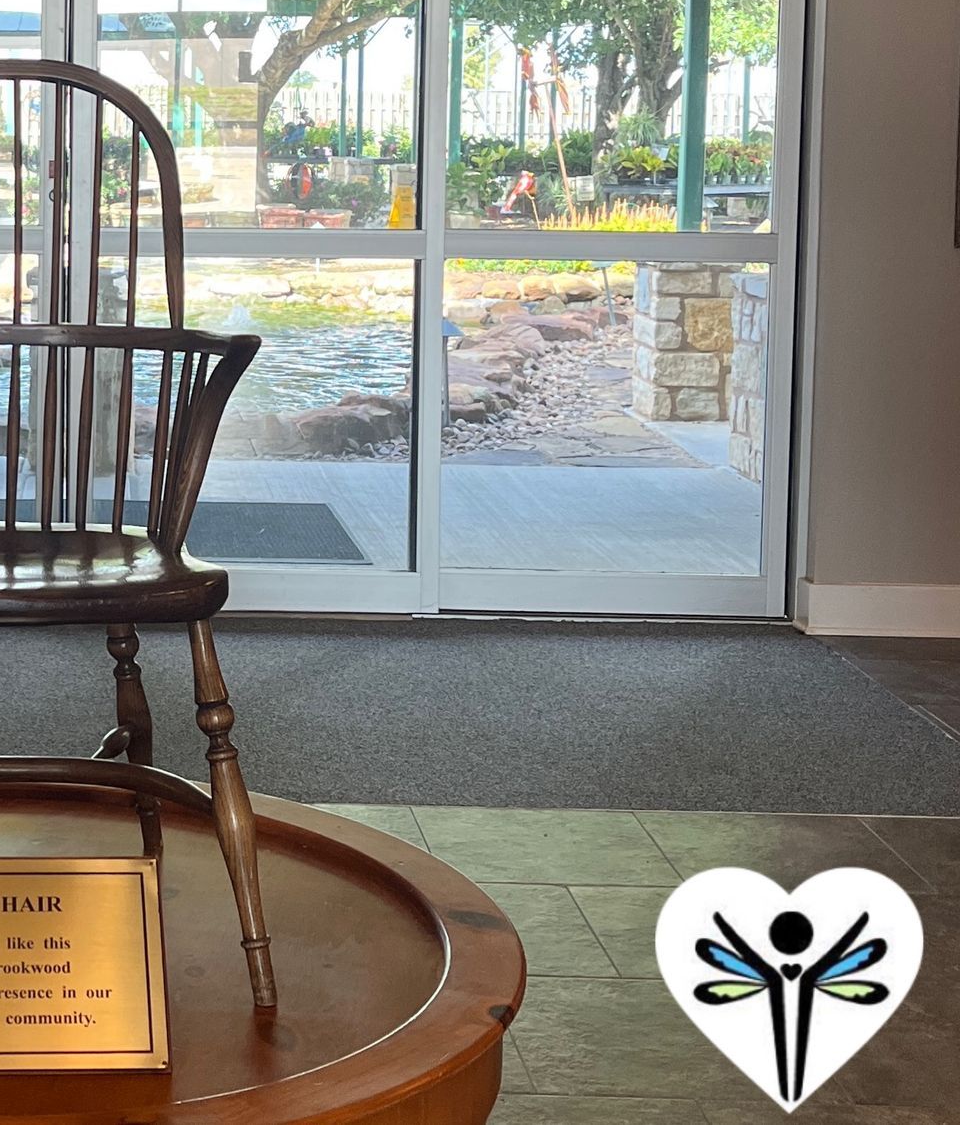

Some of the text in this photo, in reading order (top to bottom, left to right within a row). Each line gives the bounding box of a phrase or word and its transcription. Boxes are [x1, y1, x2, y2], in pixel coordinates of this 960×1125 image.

[6, 937, 35, 950] like
[43, 936, 71, 950] this
[62, 985, 77, 1000] in
[85, 988, 113, 1000] our
[5, 1011, 97, 1028] community.
